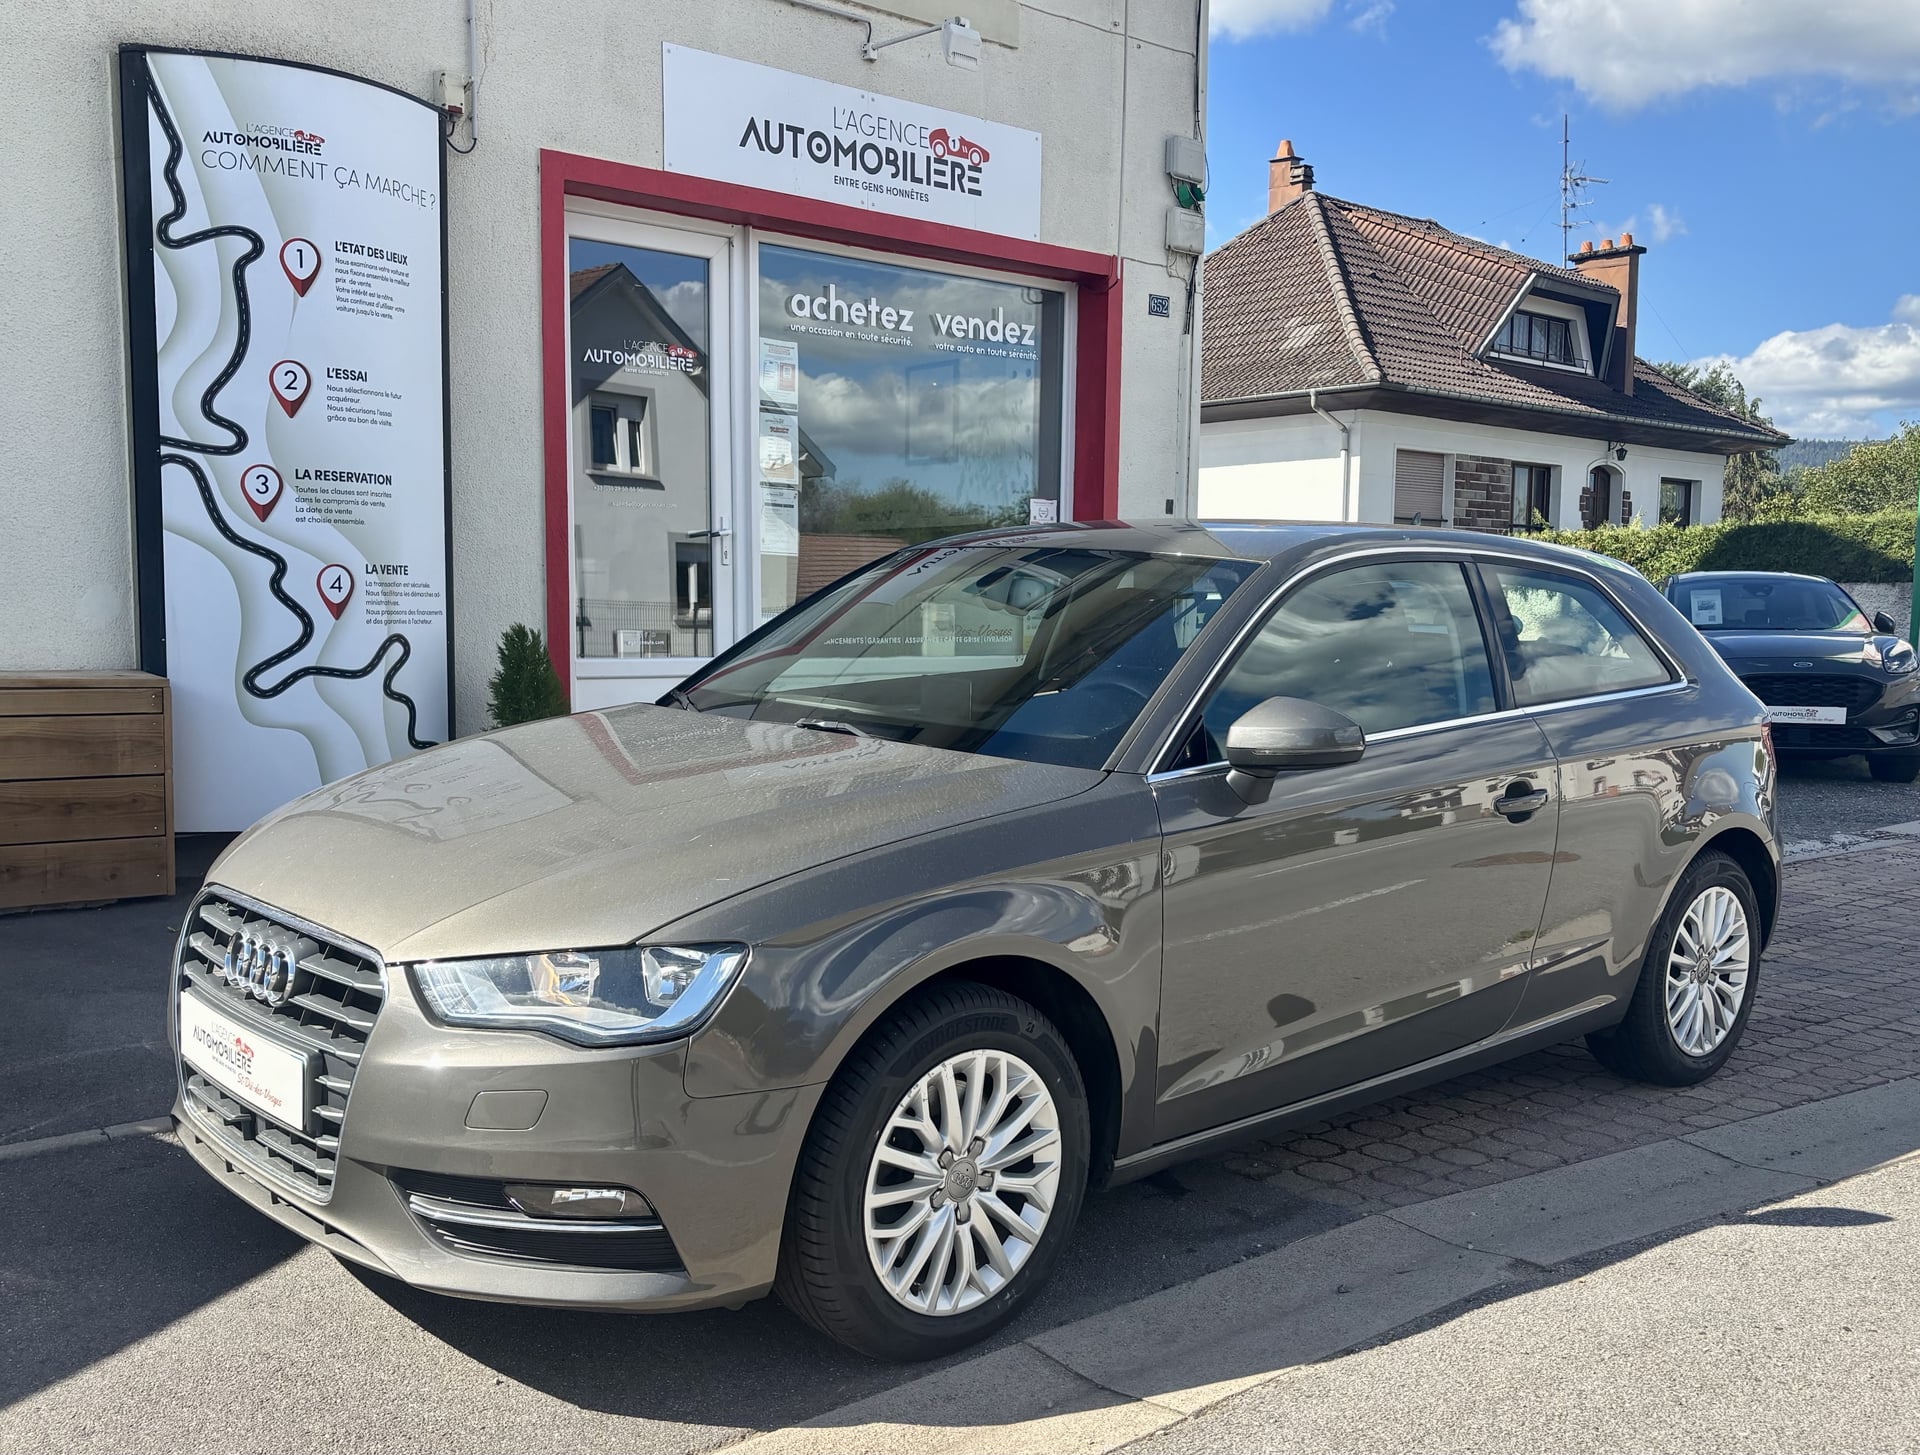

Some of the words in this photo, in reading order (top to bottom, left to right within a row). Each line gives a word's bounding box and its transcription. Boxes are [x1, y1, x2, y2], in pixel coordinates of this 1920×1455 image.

[246, 122, 295, 138] L'AGENCE
[833, 106, 929, 149] L'AGENCE
[201, 149, 328, 181] COMMENT
[334, 166, 361, 189] ÇA
[833, 174, 860, 190] ENTRE
[862, 180, 884, 194] GENS
[885, 184, 930, 204] HONNÊTES
[296, 248, 304, 270] 1
[336, 240, 366, 256] L'ETAT
[367, 246, 384, 260] DES
[386, 250, 408, 267] LIEUX
[336, 257, 350, 266] Nous
[350, 260, 378, 270] examinons
[378, 266, 390, 274] votre
[390, 268, 404, 277] voiture
[350, 268, 365, 278] fixons
[366, 273, 389, 282] ensemble
[336, 286, 350, 294] Votre
[351, 287, 368, 297] intérêt
[336, 295, 349, 303] Vous
[350, 298, 374, 307] continuez
[790, 284, 914, 333] achetez
[1152, 298, 1168, 313] 652
[336, 305, 355, 314] voiture
[936, 306, 1036, 346] vendez
[790, 323, 806, 334] une
[808, 326, 843, 338] occasion
[845, 331, 856, 339] en
[858, 332, 879, 342] toute
[880, 332, 913, 347] sécurité.
[624, 339, 668, 355] L'AGENCE
[936, 342, 954, 352] votre
[956, 344, 974, 354] auto
[988, 347, 1007, 358] toute
[1009, 348, 1038, 361] sérénité.
[284, 370, 298, 390] 2
[327, 367, 368, 382] L'ESSAI
[327, 385, 343, 393] Nous
[345, 387, 384, 397] sélectionnons
[327, 404, 344, 412] Nous
[345, 406, 376, 416] sécurisons
[327, 414, 346, 422] grâce
[255, 474, 269, 494] 3
[295, 468, 312, 480] LA
[314, 470, 392, 486] RESERVATION
[295, 486, 318, 494] Toutes
[331, 488, 355, 496] clauses
[370, 490, 392, 499] inscrites
[322, 498, 359, 506] compromis
[308, 516, 332, 524] choisie
[366, 563, 379, 575] LA
[380, 564, 409, 576] VENTE
[329, 574, 343, 593] 4
[381, 589, 403, 597] facilitons
[384, 618, 407, 626] garanties
